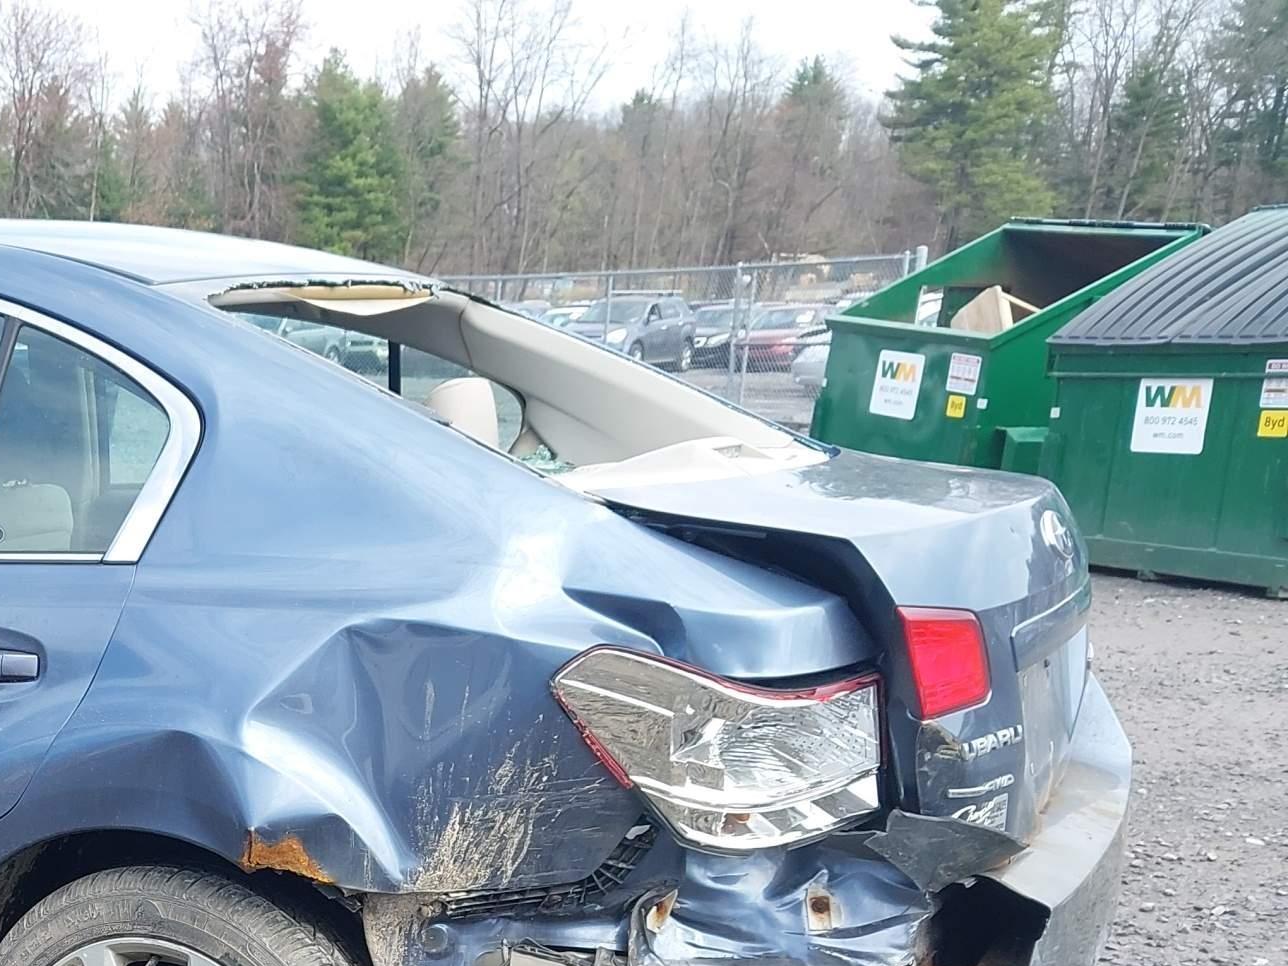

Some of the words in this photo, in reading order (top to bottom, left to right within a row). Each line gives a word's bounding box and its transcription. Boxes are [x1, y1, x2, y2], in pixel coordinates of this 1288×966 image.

[881, 360, 916, 382] WM
[1145, 385, 1201, 408] WM
[1144, 416, 1160, 425] 800
[1161, 416, 1176, 425] 972
[1178, 416, 1198, 426] 4545
